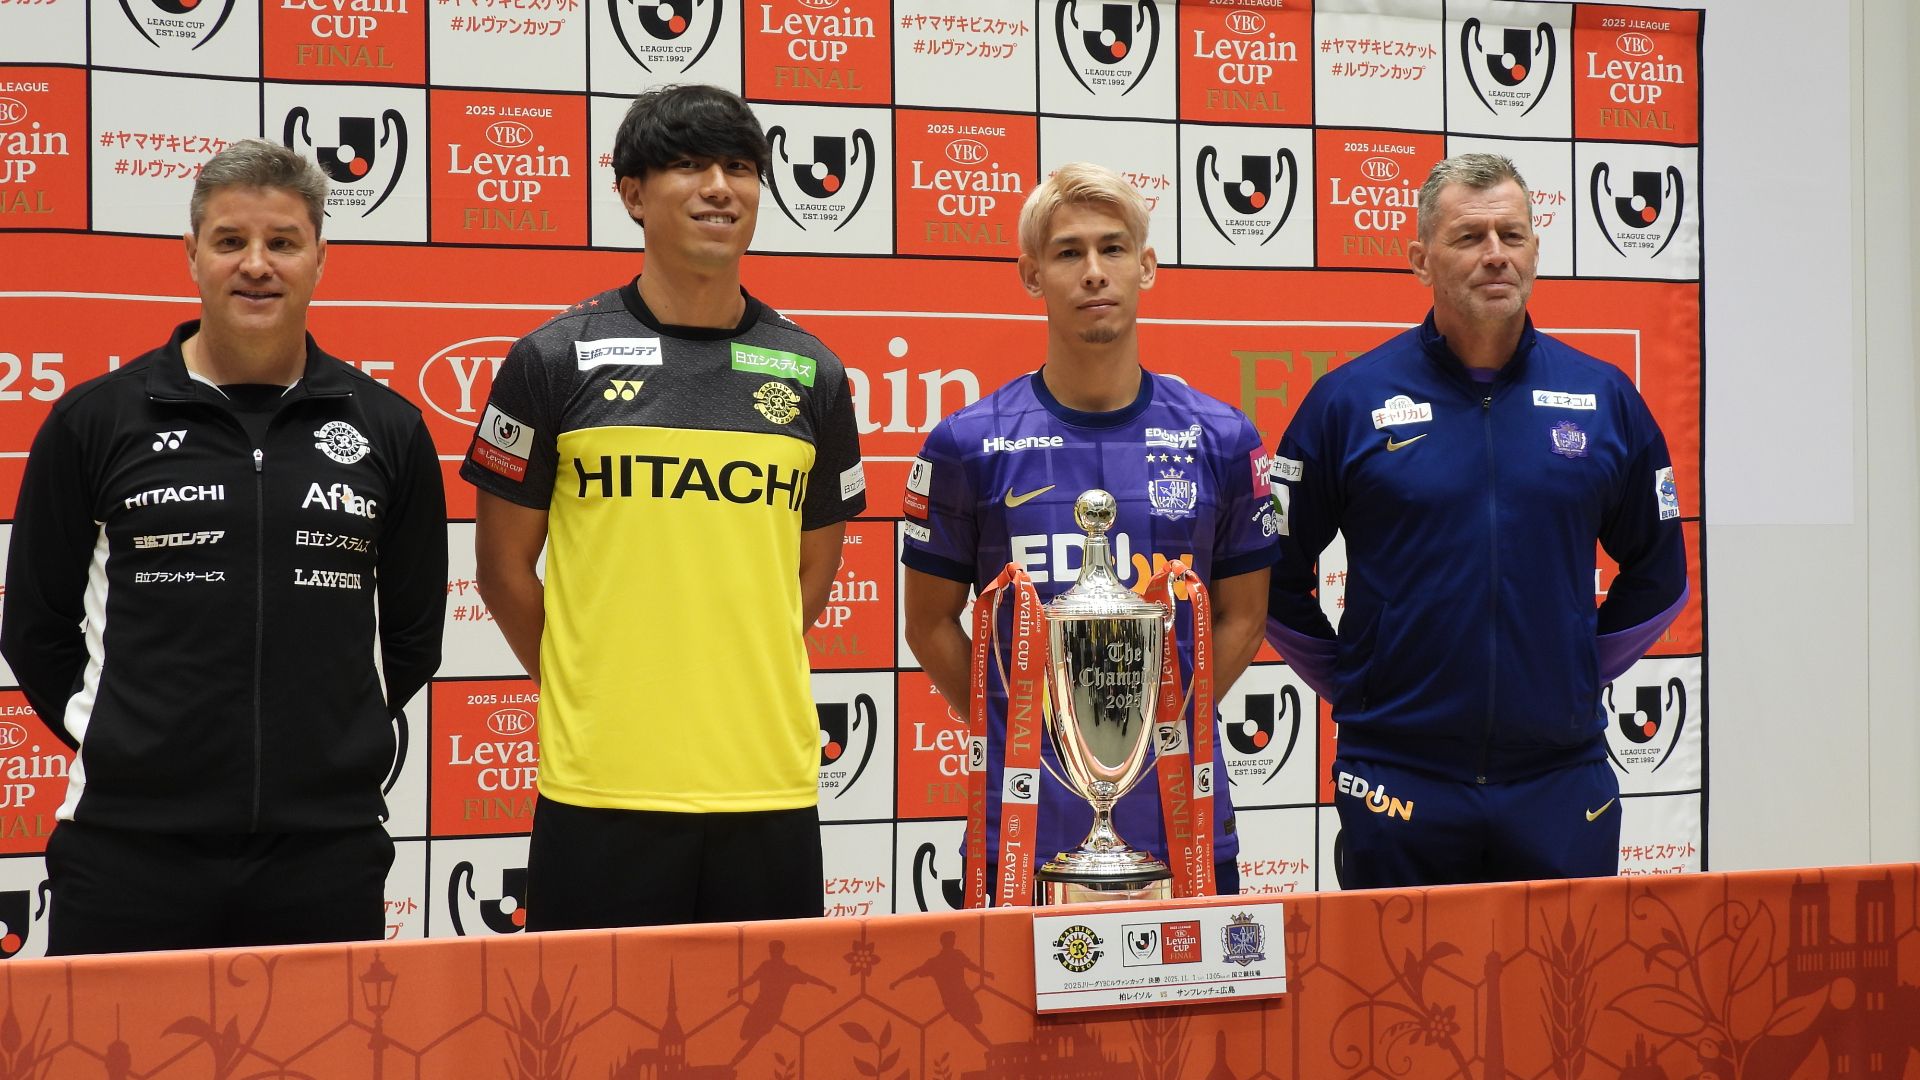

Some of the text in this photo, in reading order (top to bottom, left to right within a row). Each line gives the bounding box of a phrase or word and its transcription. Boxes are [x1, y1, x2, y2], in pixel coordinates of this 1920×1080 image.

[147, 18, 205, 30] LEAGUE CUP
[311, 14, 378, 38] CUP
[450, 16, 566, 36] #ルヴァンカップ
[760, 4, 875, 38] Levain
[900, 14, 1029, 36] #ヤマザキビスケット
[1232, 14, 1260, 31] YBC
[1602, 18, 1670, 31] 2025 J.LEAGUE
[788, 39, 848, 62] CUP
[913, 38, 1018, 59] #ルヴァンカップ
[1193, 29, 1298, 62] Levain
[1320, 37, 1437, 59] #ヤマザキビスケット
[1622, 36, 1649, 53] YBC
[296, 44, 394, 68] FINAL
[774, 66, 862, 90] FINAL
[1085, 68, 1116, 77] LEAGUE
[1218, 62, 1272, 85] CUP
[1332, 61, 1426, 81] #ルヴァンカップ
[1586, 52, 1684, 84] Levain
[0, 82, 49, 92] LEAGUE
[1488, 90, 1531, 99] LEAGUE CUP
[1609, 83, 1662, 104] CUP
[1206, 88, 1286, 112] FINAL
[0, 103, 20, 120] BC
[466, 105, 552, 118] 2025 J.LEAGUE
[1600, 107, 1676, 130] FINAL
[493, 126, 526, 144] YBC
[928, 124, 1006, 136] 2025 J.LEAGUE
[100, 130, 236, 154] #ヤマザキビスケ
[952, 144, 982, 161] YBC
[1344, 142, 1415, 155] 2025 J.LEAGUE
[448, 144, 570, 177] Levain
[1367, 161, 1394, 178] YBC
[911, 161, 1022, 193] Levain
[477, 179, 542, 203] CUP
[795, 204, 827, 212] LEAGUE
[938, 194, 996, 217] CUP
[463, 207, 558, 232] FINAL
[1354, 210, 1406, 231] CUP
[924, 221, 1008, 244] FINAL
[1343, 235, 1411, 257] FINA
[736, 351, 811, 376] 日立システムズ
[1553, 396, 1594, 406] エネコム
[1376, 408, 1429, 424] キャリカレ
[983, 436, 1064, 453] Hisense
[574, 454, 808, 512] HITACHI
[124, 484, 225, 510] HITACHI
[302, 482, 377, 519] Aflac
[296, 530, 371, 553] 日立システムズ
[135, 571, 226, 583] 日立プラントサービス
[294, 568, 362, 590] LAWSON
[1193, 582, 1205, 637] Levain
[980, 610, 989, 640] CUP
[1018, 579, 1034, 671] Levain CUP
[1106, 640, 1142, 665] The
[467, 693, 540, 705] 2025 J.LEAG
[495, 713, 528, 732] YBC
[1013, 679, 1034, 756] FINAL
[1198, 679, 1209, 752] FINAL
[0, 727, 19, 745] BC
[449, 735, 540, 765] Leva
[1620, 747, 1661, 756] LEAGUE CUP
[1168, 766, 1192, 839] FINAL
[1338, 771, 1414, 821] EDION
[463, 798, 536, 821] FINA
[972, 785, 982, 858] FINAL
[1003, 841, 1021, 899] Levain
[1196, 834, 1206, 889] Levain
[1060, 926, 1096, 940] KASHIWA
[1166, 936, 1196, 946] Levain
[1062, 959, 1096, 972] REYSOL
